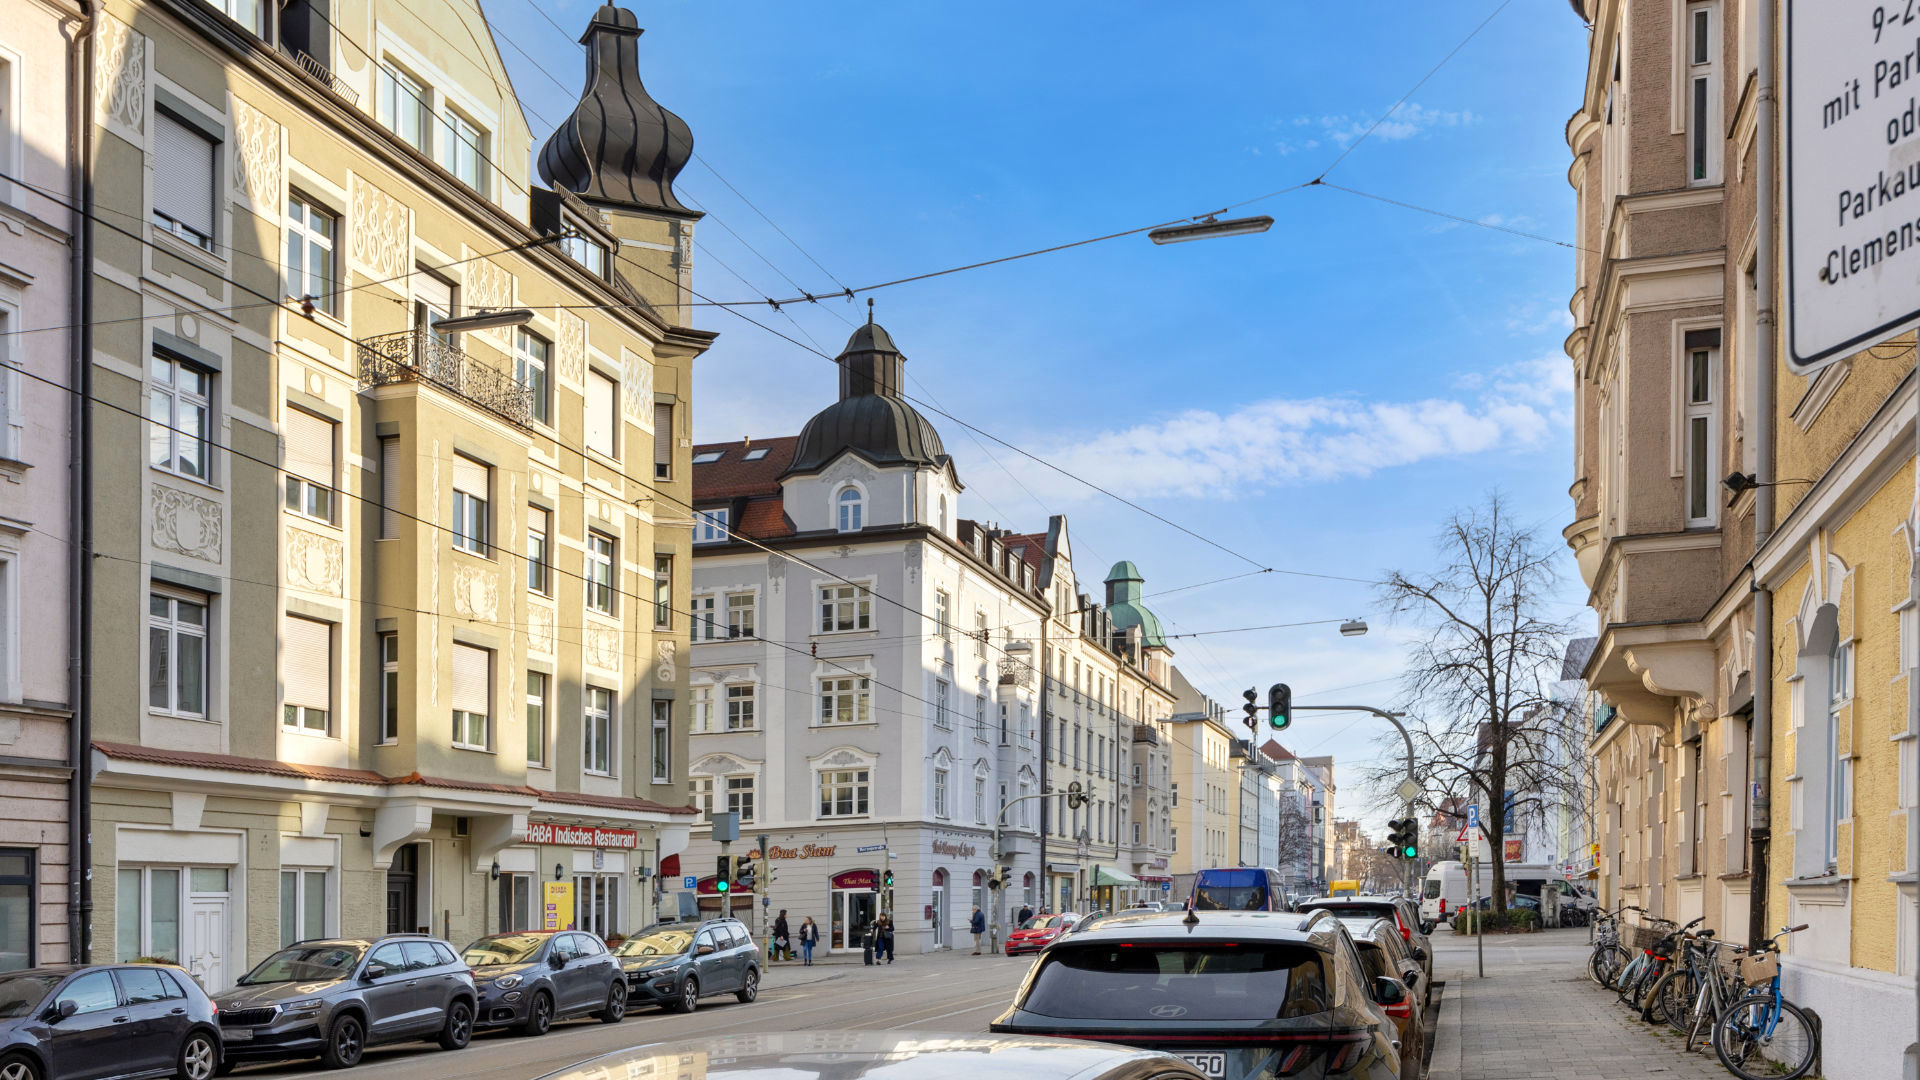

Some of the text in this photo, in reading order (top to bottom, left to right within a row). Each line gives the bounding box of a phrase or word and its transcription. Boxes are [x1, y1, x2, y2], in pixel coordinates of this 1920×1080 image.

[1872, 0, 1920, 44] 9-2
[1823, 37, 1920, 129] mit Par
[1887, 97, 1920, 145] od
[525, 824, 635, 848] HABA Indisches Restaurant
[769, 844, 837, 859] Bua Siam
[1184, 1056, 1221, 1074] 50
